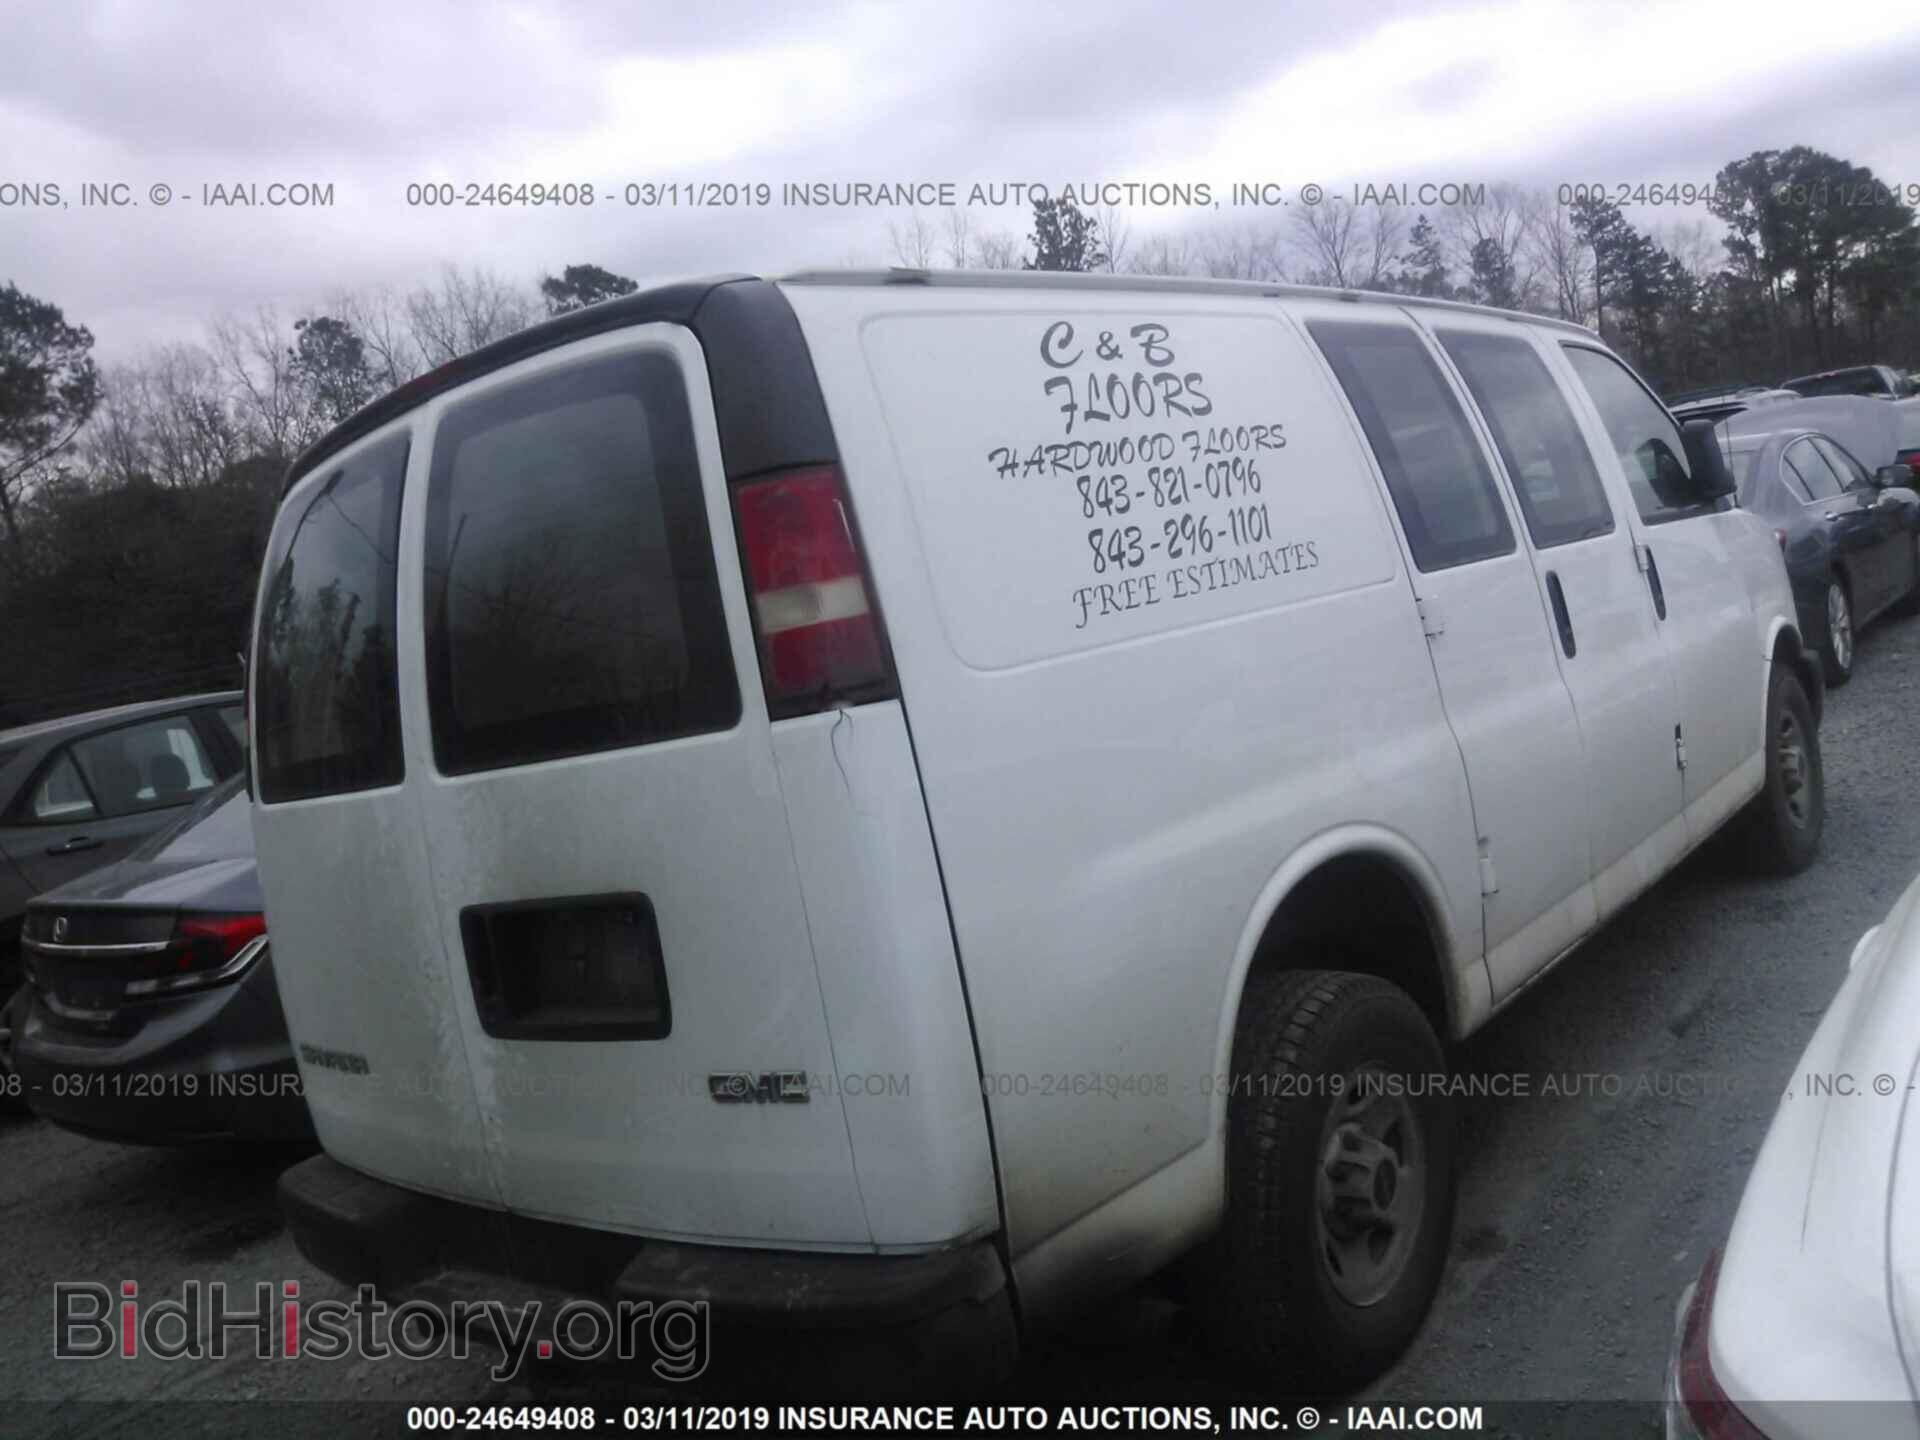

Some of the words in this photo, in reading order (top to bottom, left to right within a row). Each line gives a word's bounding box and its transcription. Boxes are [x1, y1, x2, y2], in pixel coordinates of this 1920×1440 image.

[1040, 320, 1084, 369] C
[1096, 331, 1123, 361] &
[1130, 323, 1175, 367] B
[988, 433, 1175, 480] HARDWOOD
[1076, 456, 1262, 518] 843-821-0796
[1087, 503, 1272, 574] 843-296-1101
[1073, 574, 1161, 629] FREE
[1166, 540, 1320, 600] ESTIMATES
